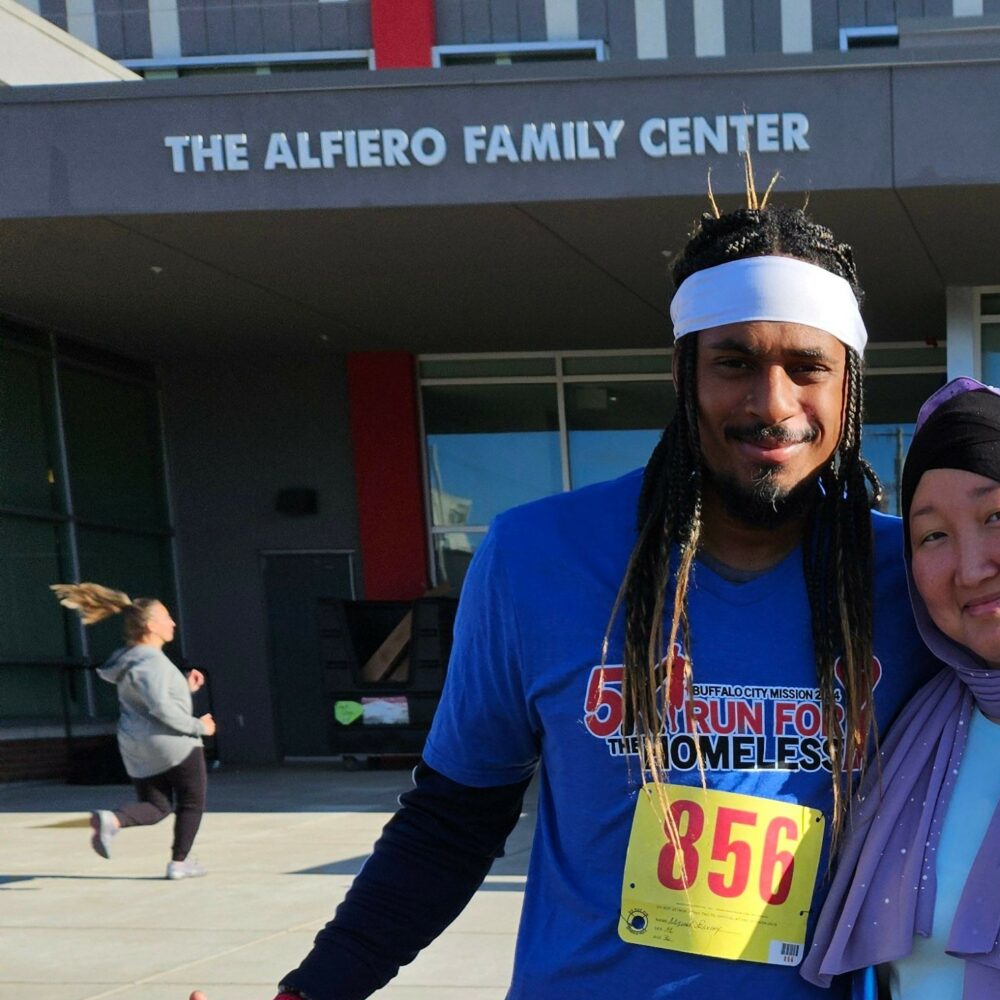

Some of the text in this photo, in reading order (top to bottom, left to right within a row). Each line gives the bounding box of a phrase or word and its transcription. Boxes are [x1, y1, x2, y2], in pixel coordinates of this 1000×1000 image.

[163, 112, 811, 173] THE ALFIERO FAMILY CENTER
[692, 684, 742, 698] BUFFALO
[743, 686, 769, 699] CITY
[770, 687, 813, 701] MISSION
[684, 699, 763, 736] RUN
[606, 736, 640, 756] THE
[656, 798, 799, 906] 856
